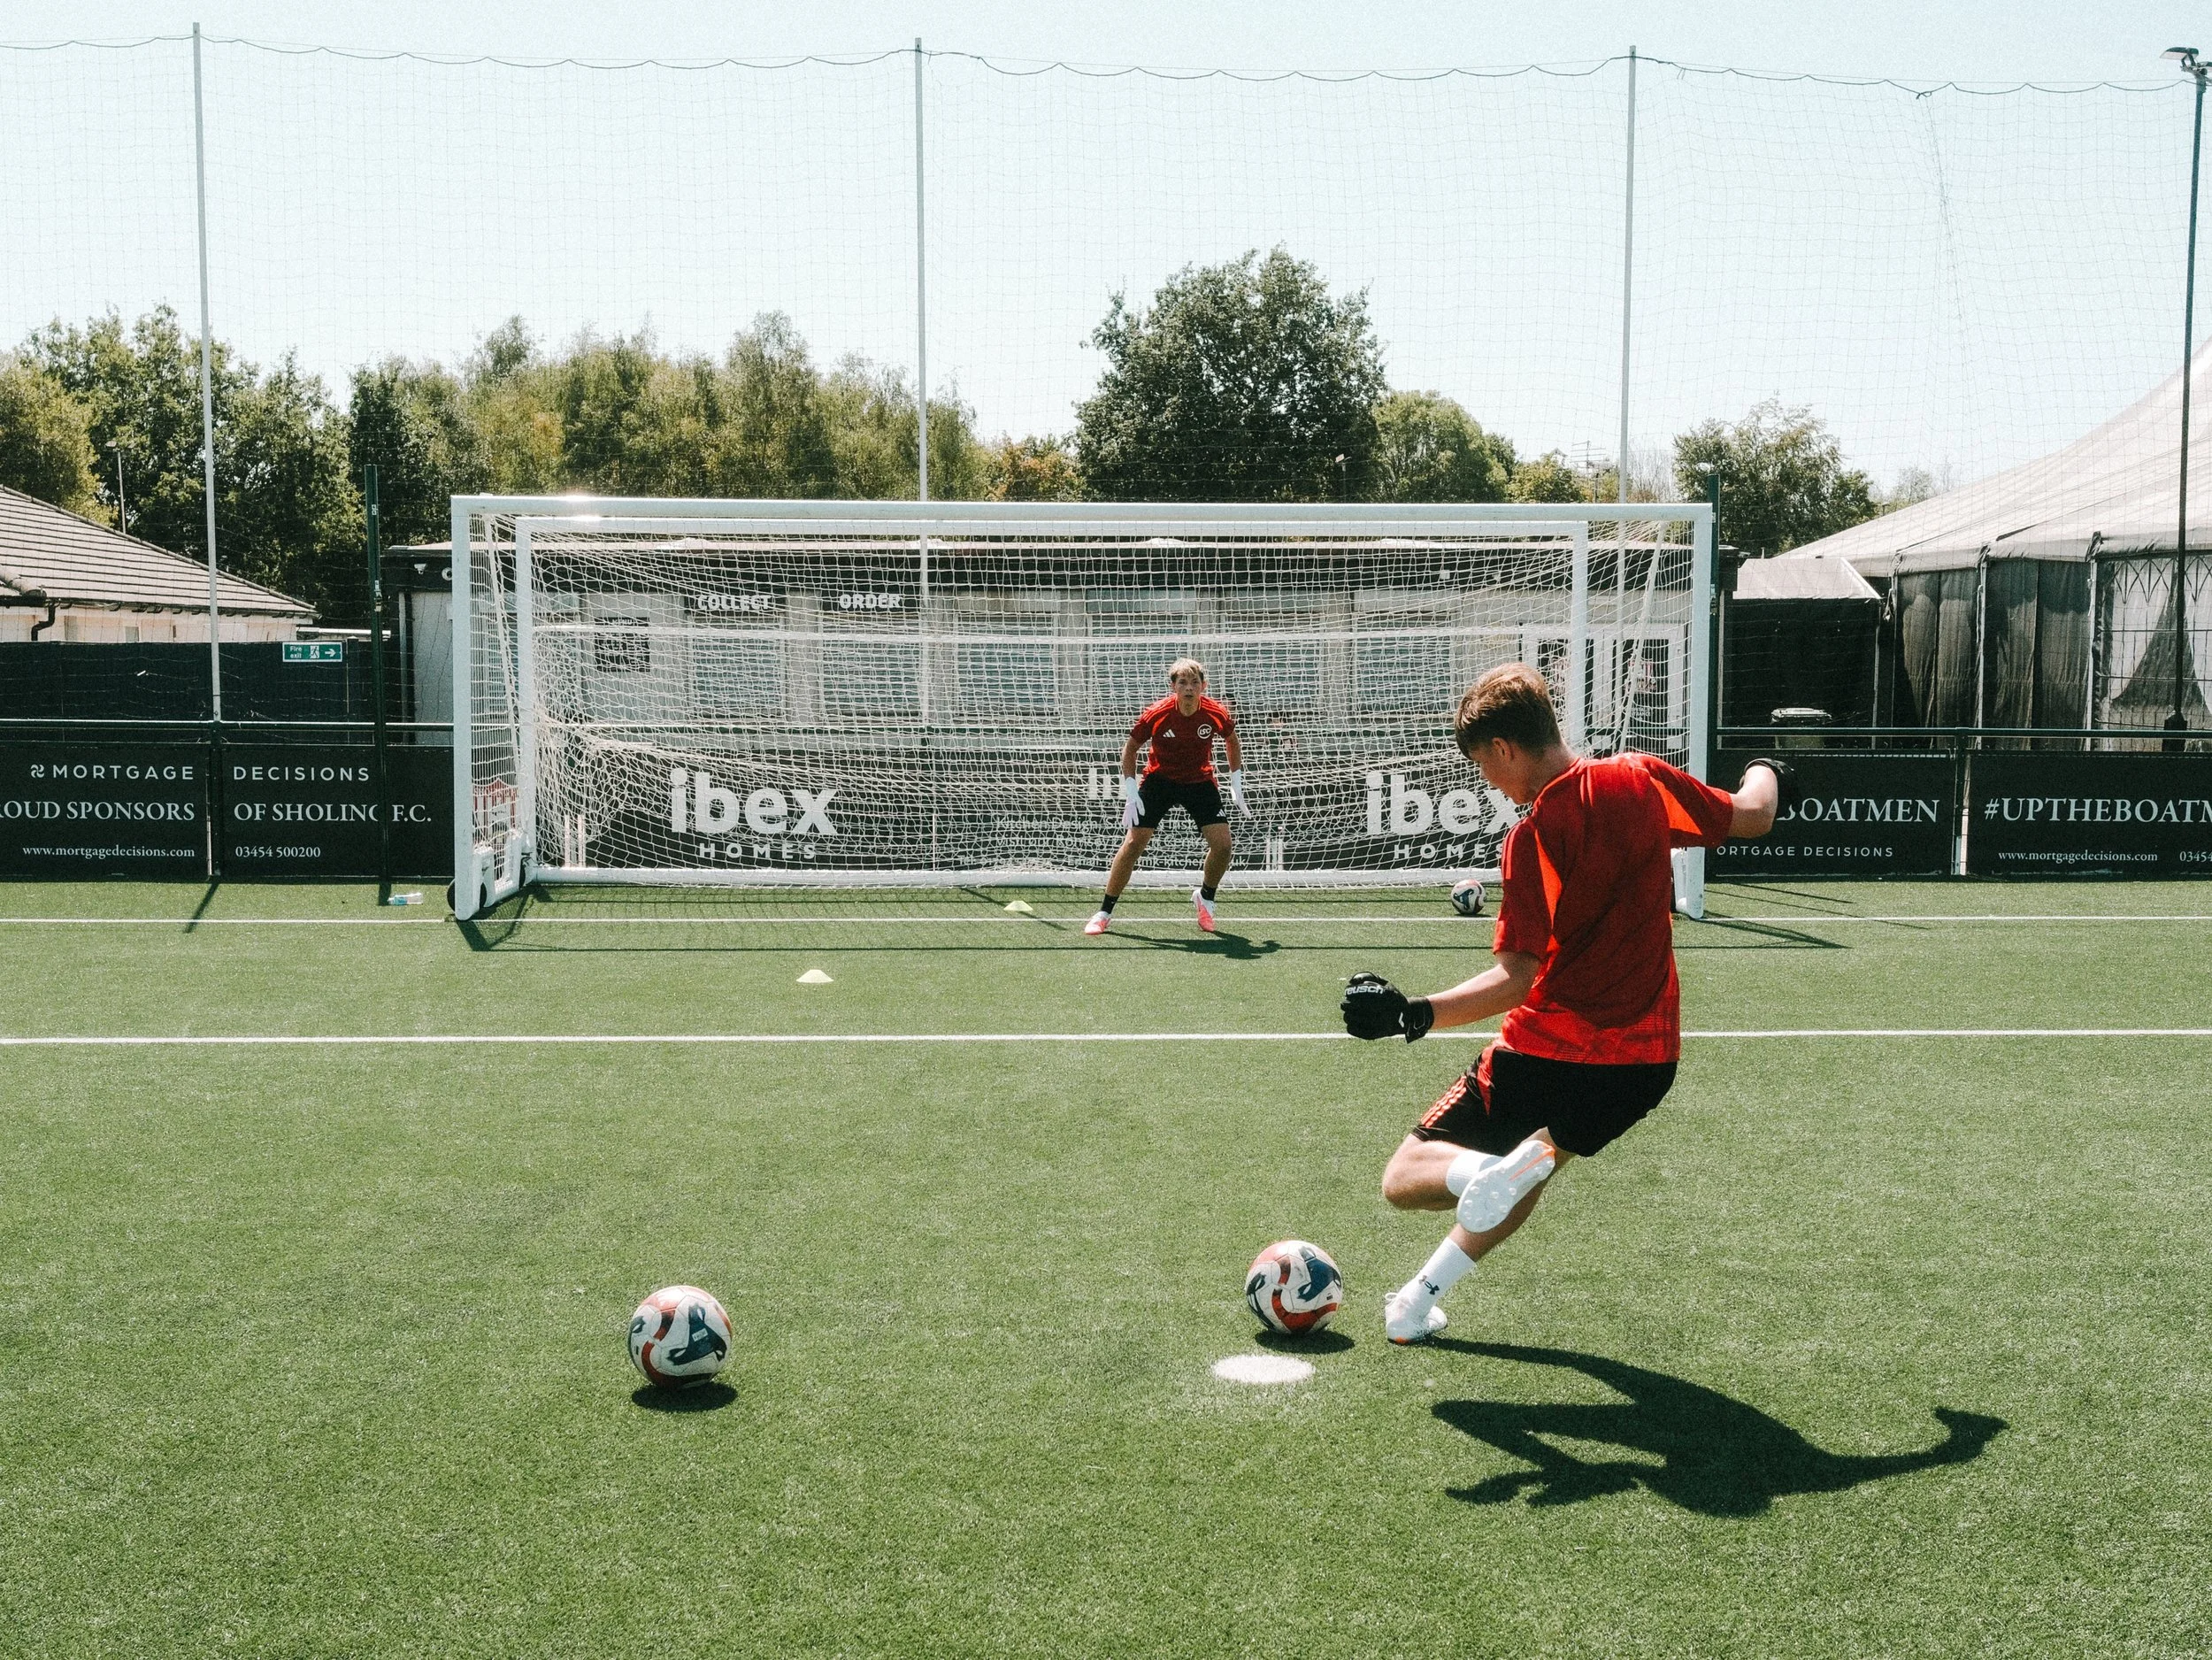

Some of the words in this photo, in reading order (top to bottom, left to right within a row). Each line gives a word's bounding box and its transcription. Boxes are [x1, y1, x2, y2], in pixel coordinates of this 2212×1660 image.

[697, 595, 772, 610] COLLECT
[840, 593, 902, 609] ORDER
[52, 765, 195, 780] MORTGAGE
[233, 766, 370, 781] DECISIONS
[670, 767, 839, 834] ibex
[1365, 771, 1520, 835] ibex
[0, 800, 61, 819] OUD
[66, 801, 196, 821] SPONSORS
[234, 803, 266, 821] OF
[391, 803, 432, 823] F.C.
[22, 844, 196, 860] www.mortgagedecisions.com
[234, 846, 273, 858] 03454
[276, 846, 321, 858] 500200
[698, 842, 817, 859] HOMES
[1717, 845, 1795, 857] ORTGAGE
[1803, 847, 1893, 857] DECISIONS
[1998, 849, 2158, 865] www.mortgagedecisions.com
